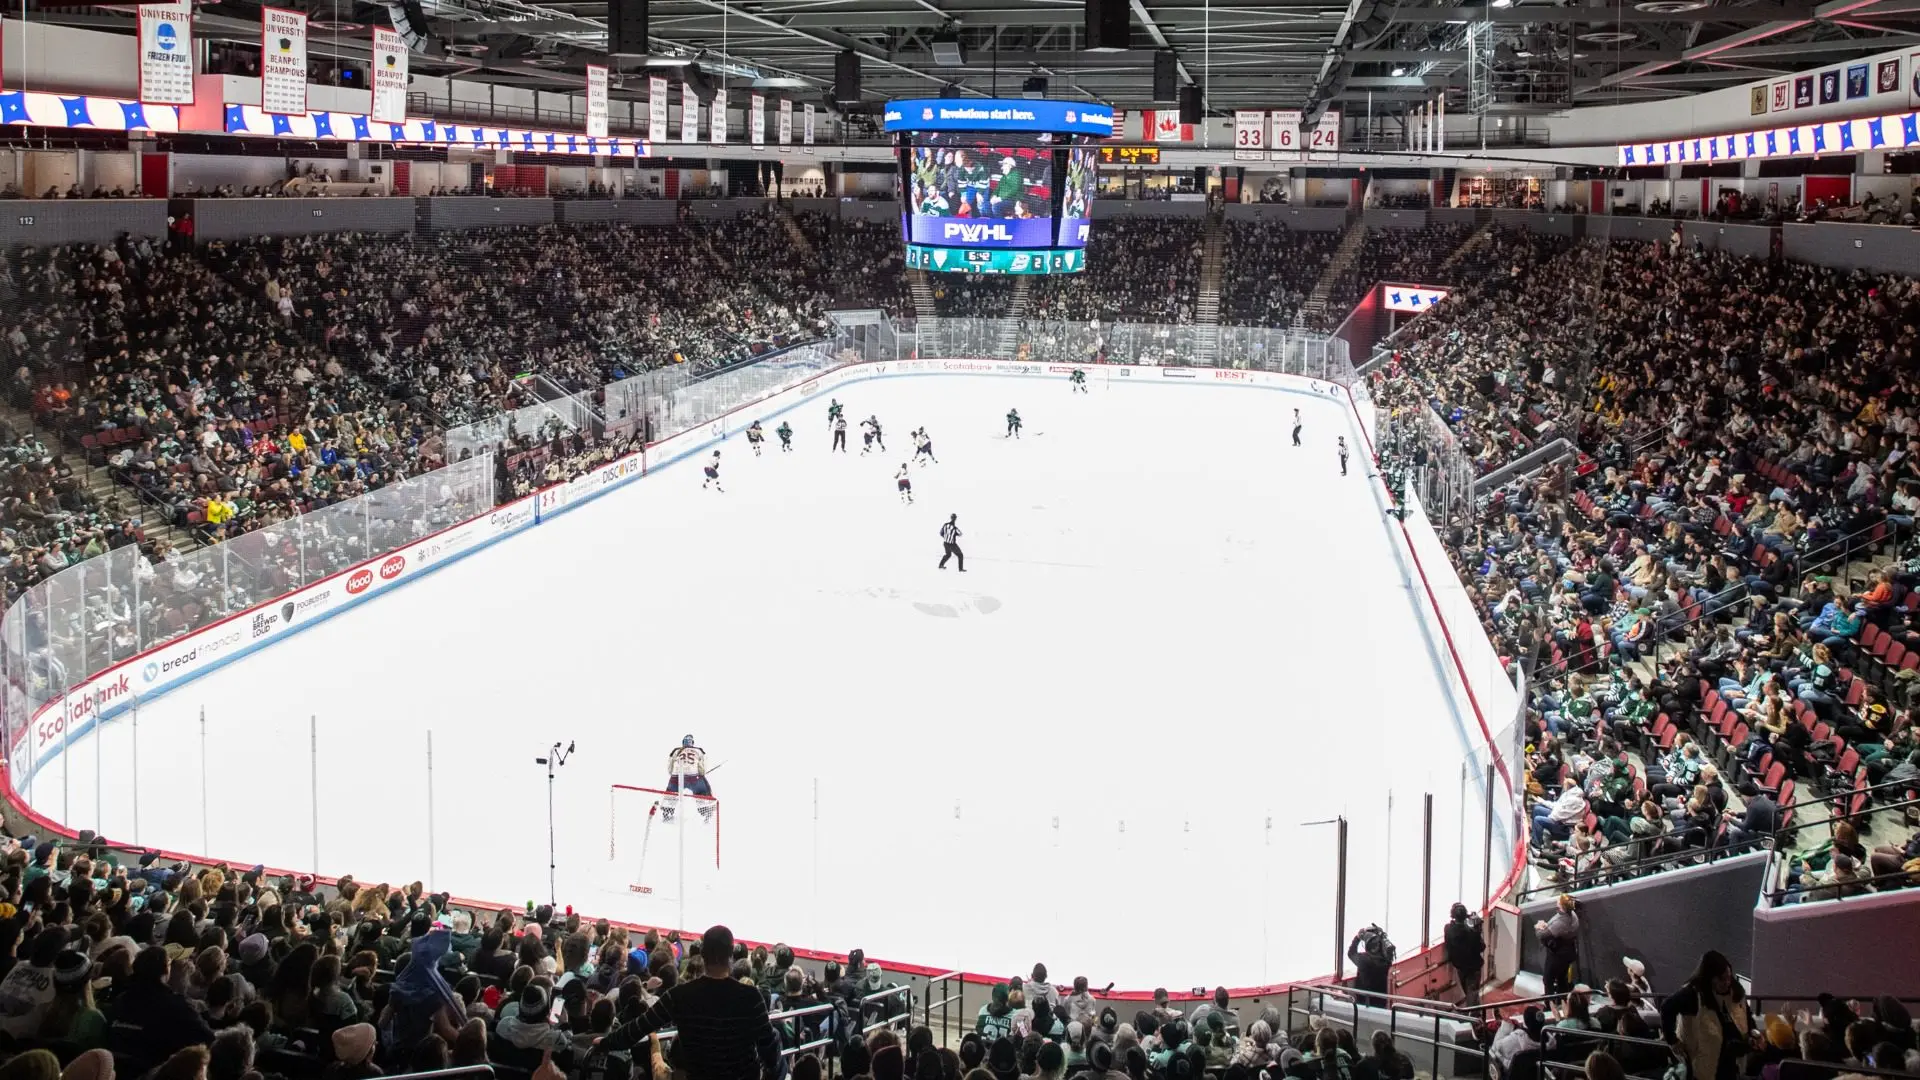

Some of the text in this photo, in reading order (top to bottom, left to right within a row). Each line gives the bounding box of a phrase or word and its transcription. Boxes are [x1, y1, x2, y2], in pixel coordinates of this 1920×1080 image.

[141, 9, 190, 22] UNIVERSITY
[271, 13, 299, 26] BOSTON
[265, 23, 305, 37] UNIVERSITY
[265, 65, 305, 78] CHAMPIONS
[376, 79, 407, 91] HAMPIONS
[940, 108, 989, 120] Revolutions
[990, 109, 1011, 120] start
[1012, 109, 1036, 121] here.
[1239, 129, 1261, 146] 33
[1280, 130, 1292, 146] 6
[1313, 130, 1336, 146] 24
[19, 216, 34, 225] 112
[944, 223, 1013, 243] PWHL
[923, 253, 930, 264] 2
[968, 251, 991, 261] 6:42
[1054, 257, 1062, 268] 2
[1034, 257, 1042, 269] 2
[943, 361, 993, 371] Scotiabank
[382, 559, 404, 576] Hood
[347, 572, 372, 591] Hood
[253, 614, 278, 631] BREWED
[253, 625, 271, 638] LOUD
[162, 648, 197, 673] bread
[38, 673, 129, 749] Scoiabank
